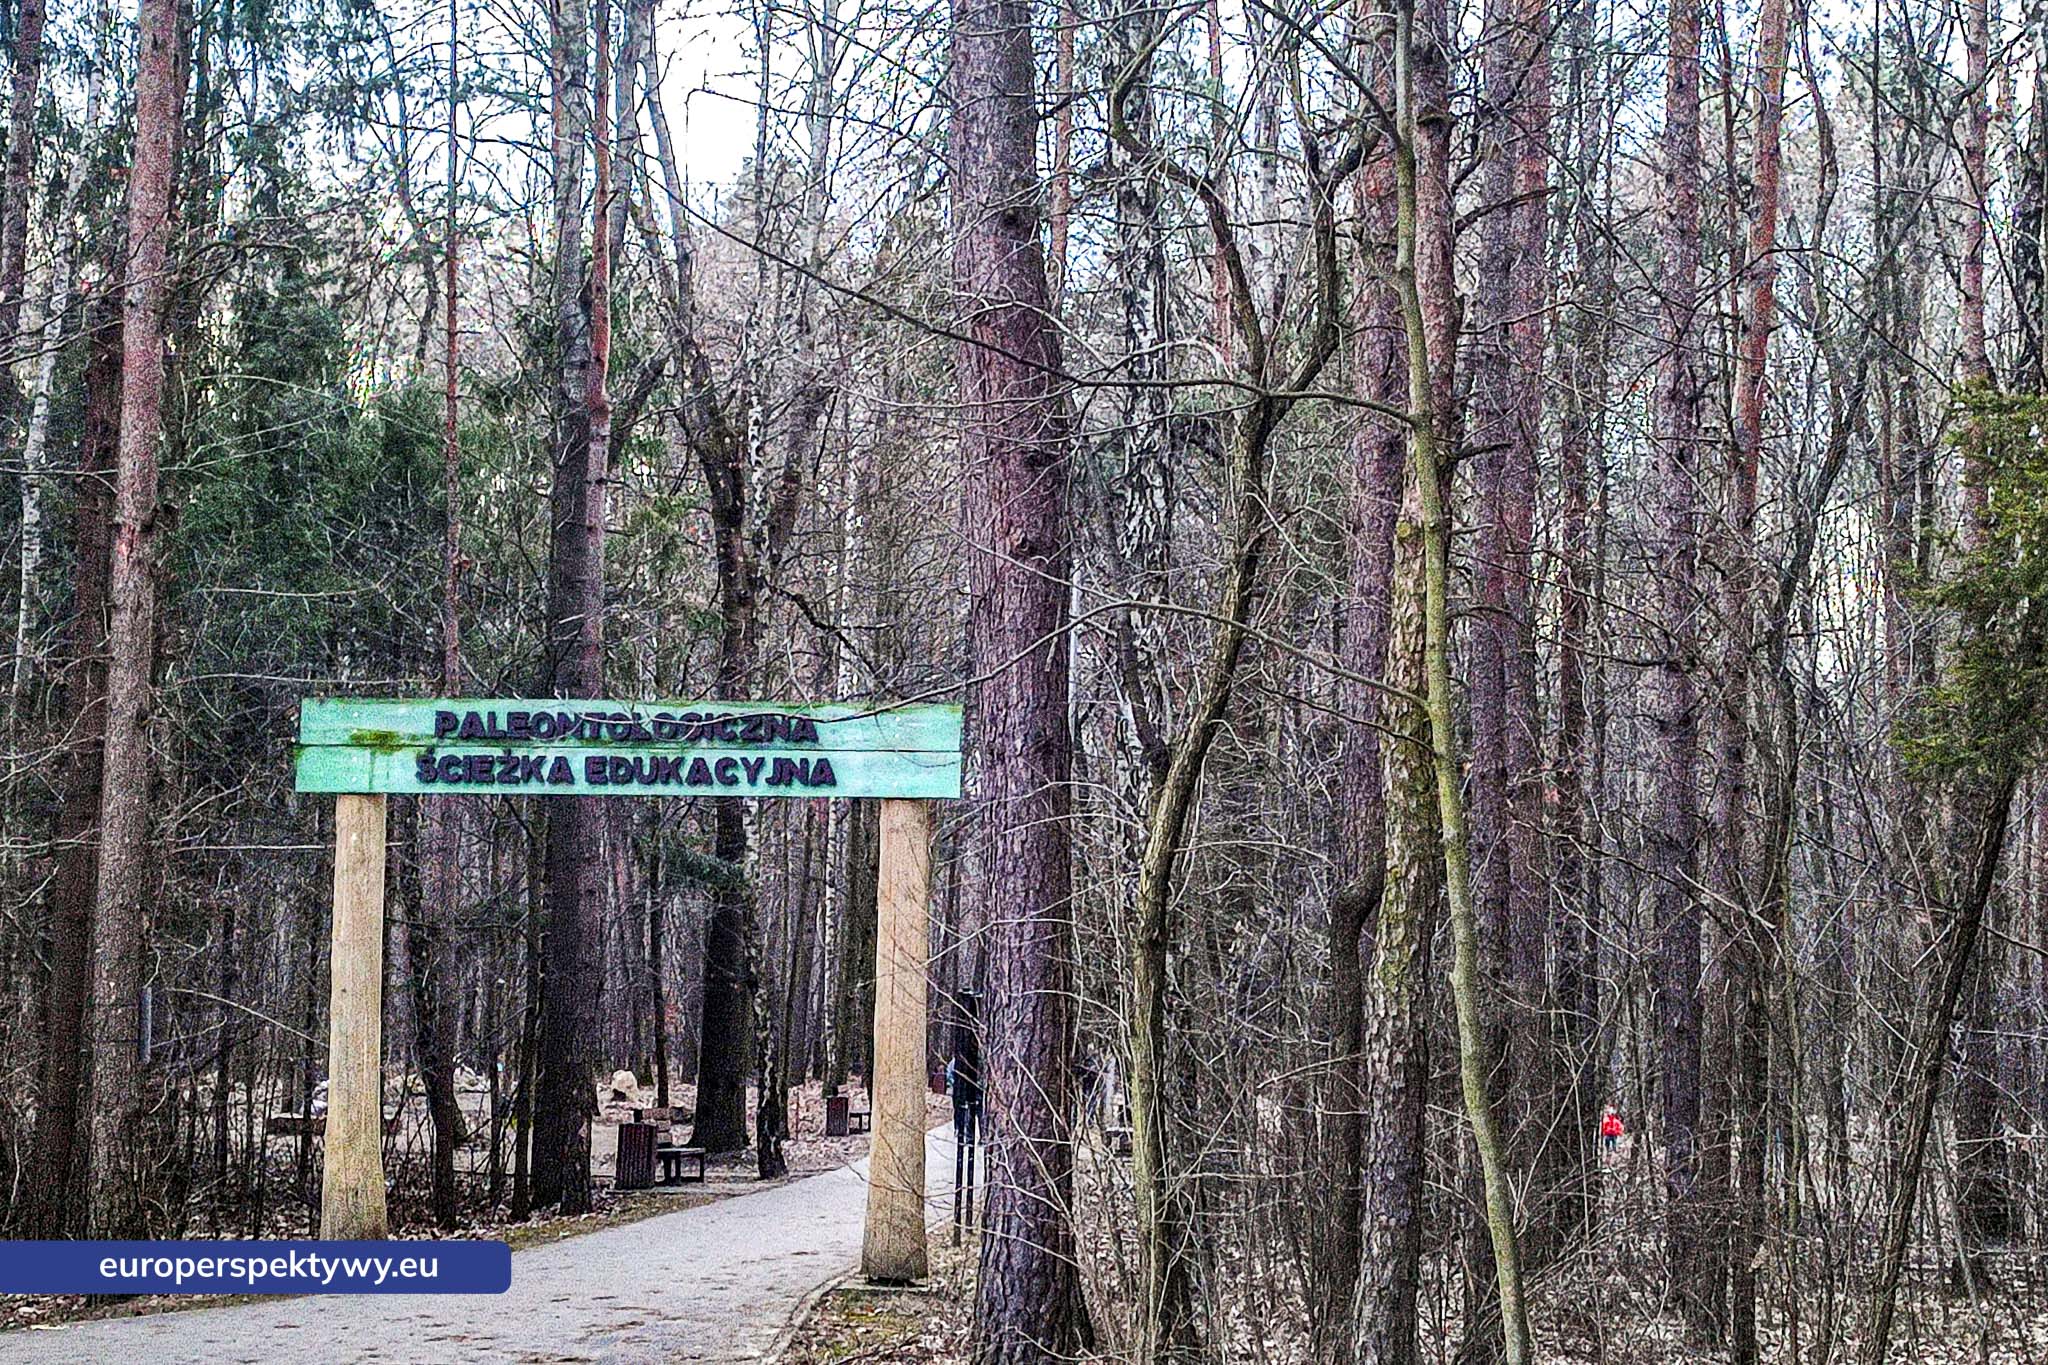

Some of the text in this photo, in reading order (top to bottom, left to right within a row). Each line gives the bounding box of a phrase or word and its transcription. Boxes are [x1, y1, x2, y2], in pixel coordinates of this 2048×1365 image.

[435, 711, 818, 742] PALEONTOLOGICZNA
[416, 747, 836, 787] ŚCIEŻKA EDUKACYJNA
